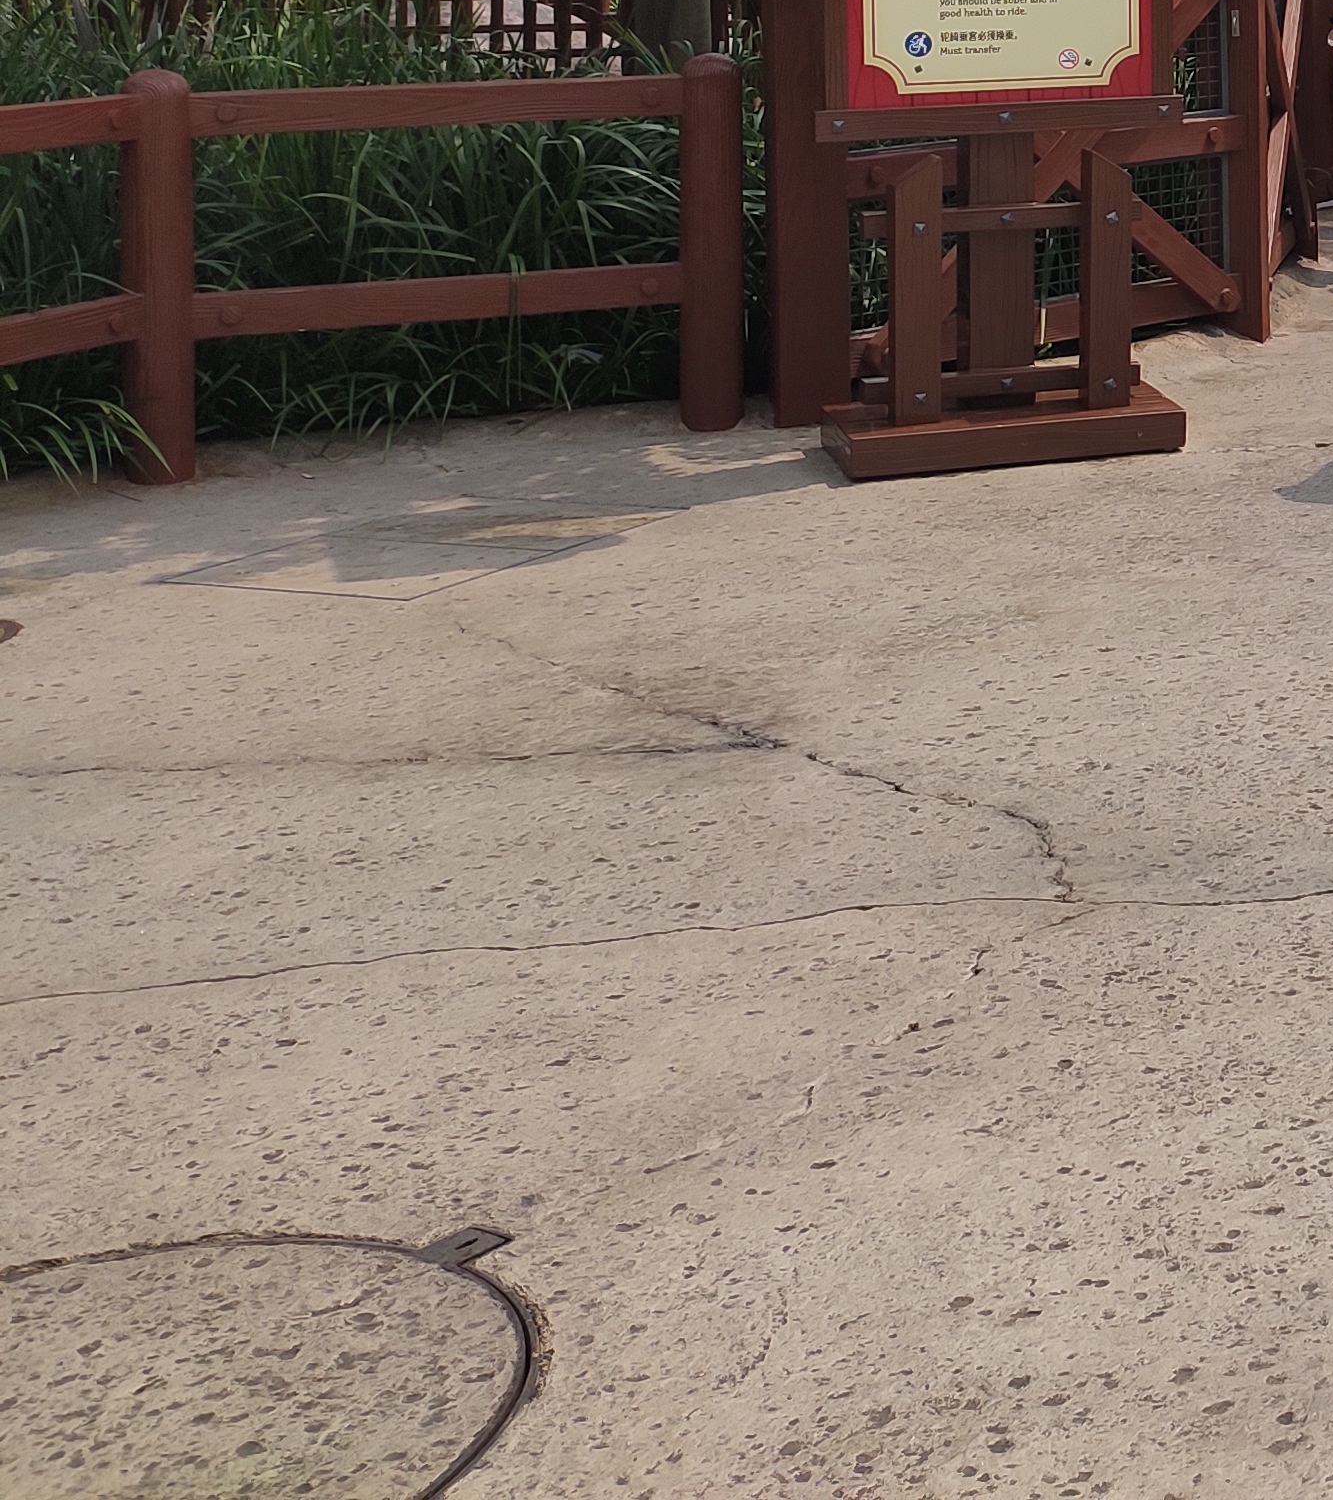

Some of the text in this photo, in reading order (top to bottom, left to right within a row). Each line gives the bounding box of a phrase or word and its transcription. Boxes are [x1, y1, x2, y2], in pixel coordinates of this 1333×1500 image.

[940, 7, 1027, 20] good health to ride.
[940, 45, 1001, 55] Must transfer
